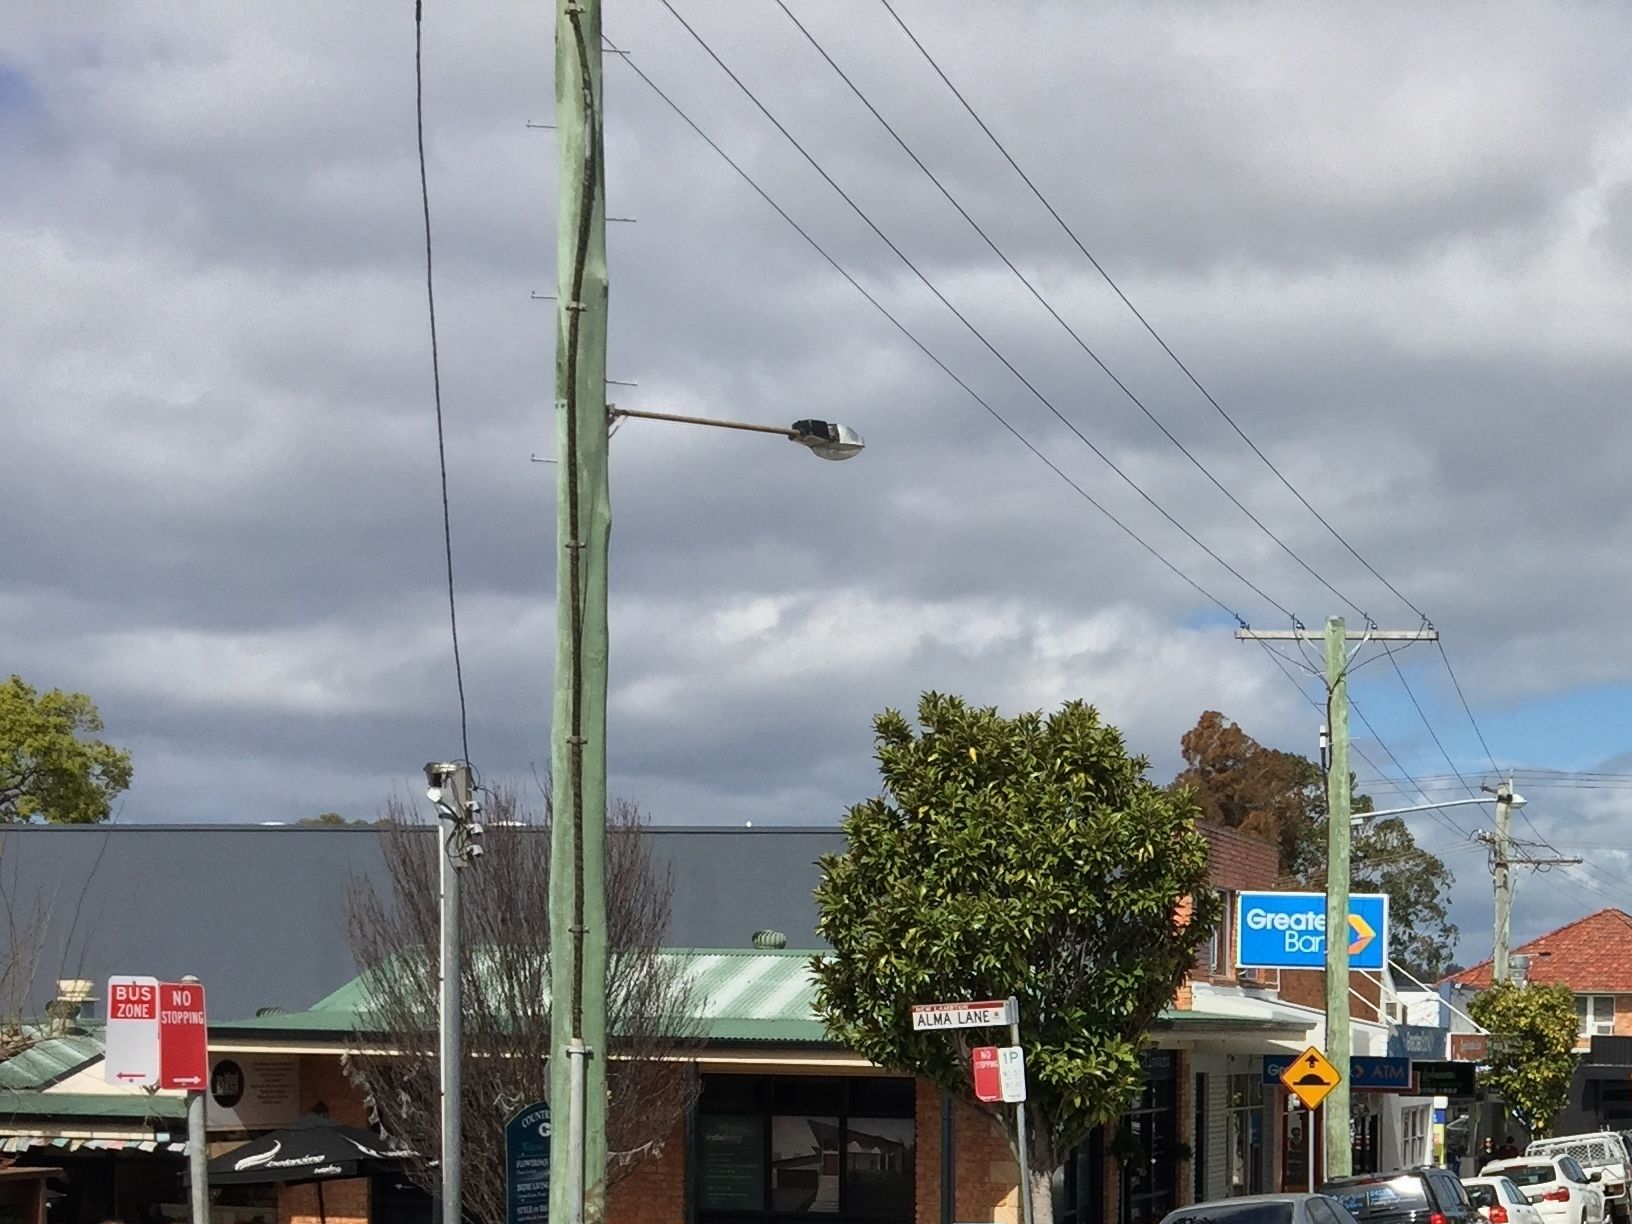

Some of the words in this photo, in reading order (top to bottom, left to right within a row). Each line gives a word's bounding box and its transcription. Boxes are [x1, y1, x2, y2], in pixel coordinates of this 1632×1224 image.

[1246, 908, 1326, 930] Greate
[1285, 930, 1326, 953] Ban
[116, 986, 151, 1001] BUS
[172, 990, 191, 1006] NO
[117, 1003, 150, 1018] ZONE
[161, 1011, 205, 1024] STOPPING
[918, 1012, 952, 1027] ALMA
[958, 1010, 990, 1025] LANE
[1371, 1065, 1404, 1079] ATM
